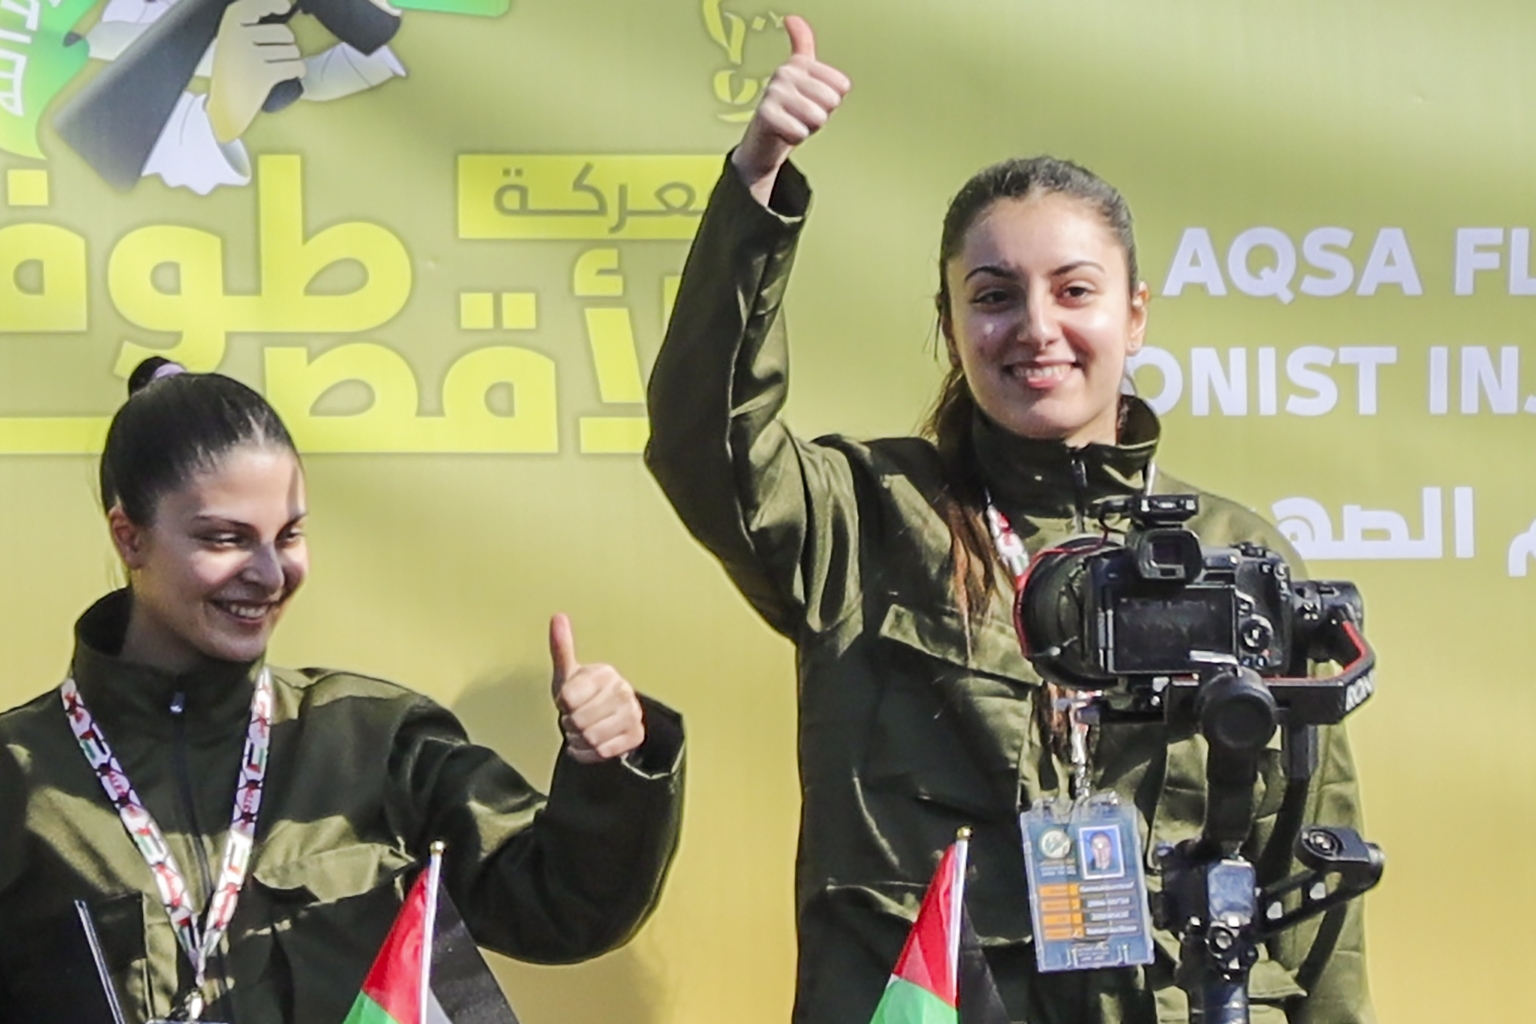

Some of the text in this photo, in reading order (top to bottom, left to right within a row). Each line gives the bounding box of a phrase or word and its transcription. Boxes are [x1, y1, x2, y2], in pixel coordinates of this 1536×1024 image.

[493, 162, 706, 234] عركة
[1161, 225, 1424, 305] AQSA
[1120, 345, 1536, 417] ONIST IN
